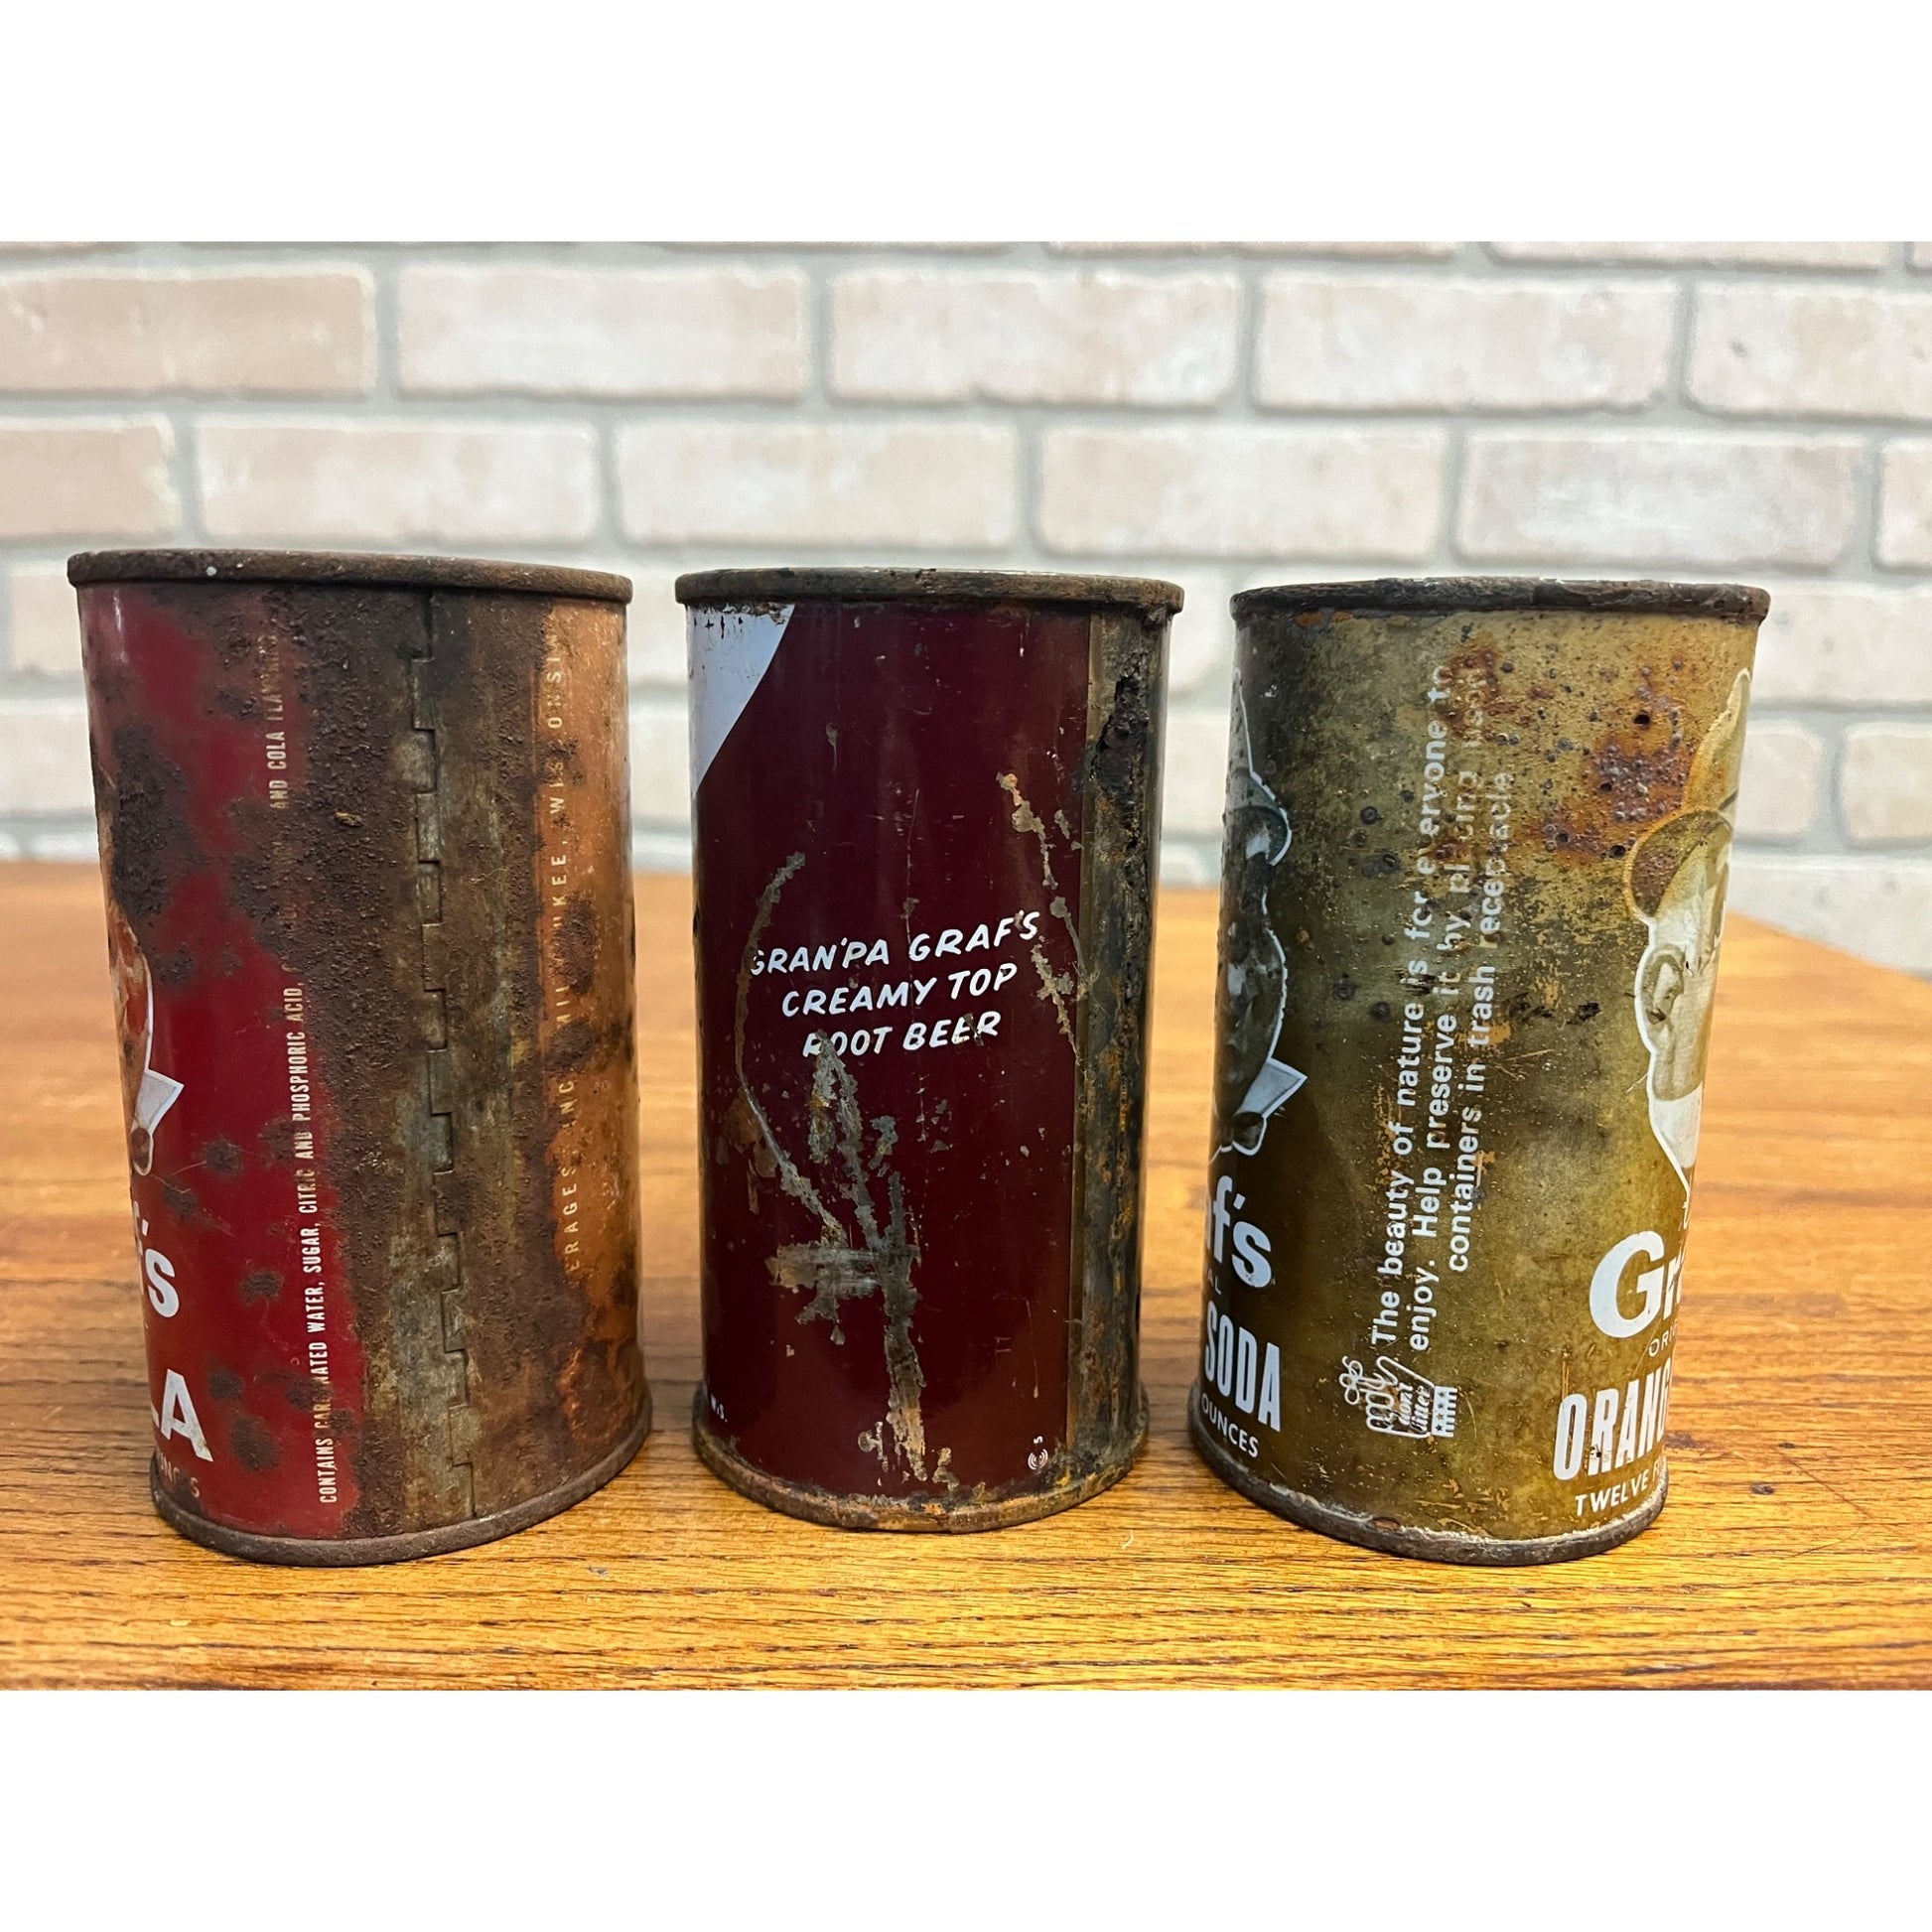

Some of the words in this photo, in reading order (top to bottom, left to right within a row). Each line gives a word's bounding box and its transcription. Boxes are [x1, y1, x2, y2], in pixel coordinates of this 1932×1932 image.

[1428, 665, 1452, 702] to
[265, 731, 287, 770] COLA
[547, 634, 565, 814] WISONSIN
[269, 779, 290, 810] AND
[1417, 720, 1448, 874] eeryone
[1444, 770, 1485, 893] plcing
[751, 937, 890, 976] GRAN'PA
[908, 909, 1040, 962] GRAF'S
[1404, 891, 1432, 939] for
[1437, 910, 1472, 951] by
[283, 982, 305, 1023] ACID,
[781, 977, 937, 1018] CREAMY
[948, 962, 1018, 1000] TOP
[1399, 960, 1428, 985] is
[1433, 971, 1460, 995] it
[802, 1026, 894, 1057] ROOT
[902, 1011, 1002, 1050] BEER
[1467, 965, 1496, 1048] trash
[286, 1031, 311, 1122] PHOSPHORIC
[1396, 1002, 1425, 1107] nature
[1426, 1014, 1456, 1150] preserve
[1458, 1061, 1486, 1091] in
[294, 1131, 314, 1160] AND
[1388, 1122, 1414, 1156] of
[297, 1168, 318, 1214] CITRIC
[1411, 1166, 1447, 1237] Help
[1449, 1105, 1483, 1274] containers
[300, 1222, 323, 1274] SUGAR,
[1376, 1170, 1415, 1276] beauty
[305, 1282, 327, 1333] WATER,
[1406, 1259, 1440, 1351] enjoy.
[1589, 1230, 1683, 1338] Gr
[1371, 1291, 1401, 1345] The
[309, 1341, 332, 1430] CARNATED
[1204, 1301, 1281, 1432] SODA
[150, 1369, 213, 1461] A
[1201, 1392, 1259, 1458] OUNCES
[315, 1437, 338, 1504] CONTAINS
[1575, 1468, 1650, 1517] TWELVE
